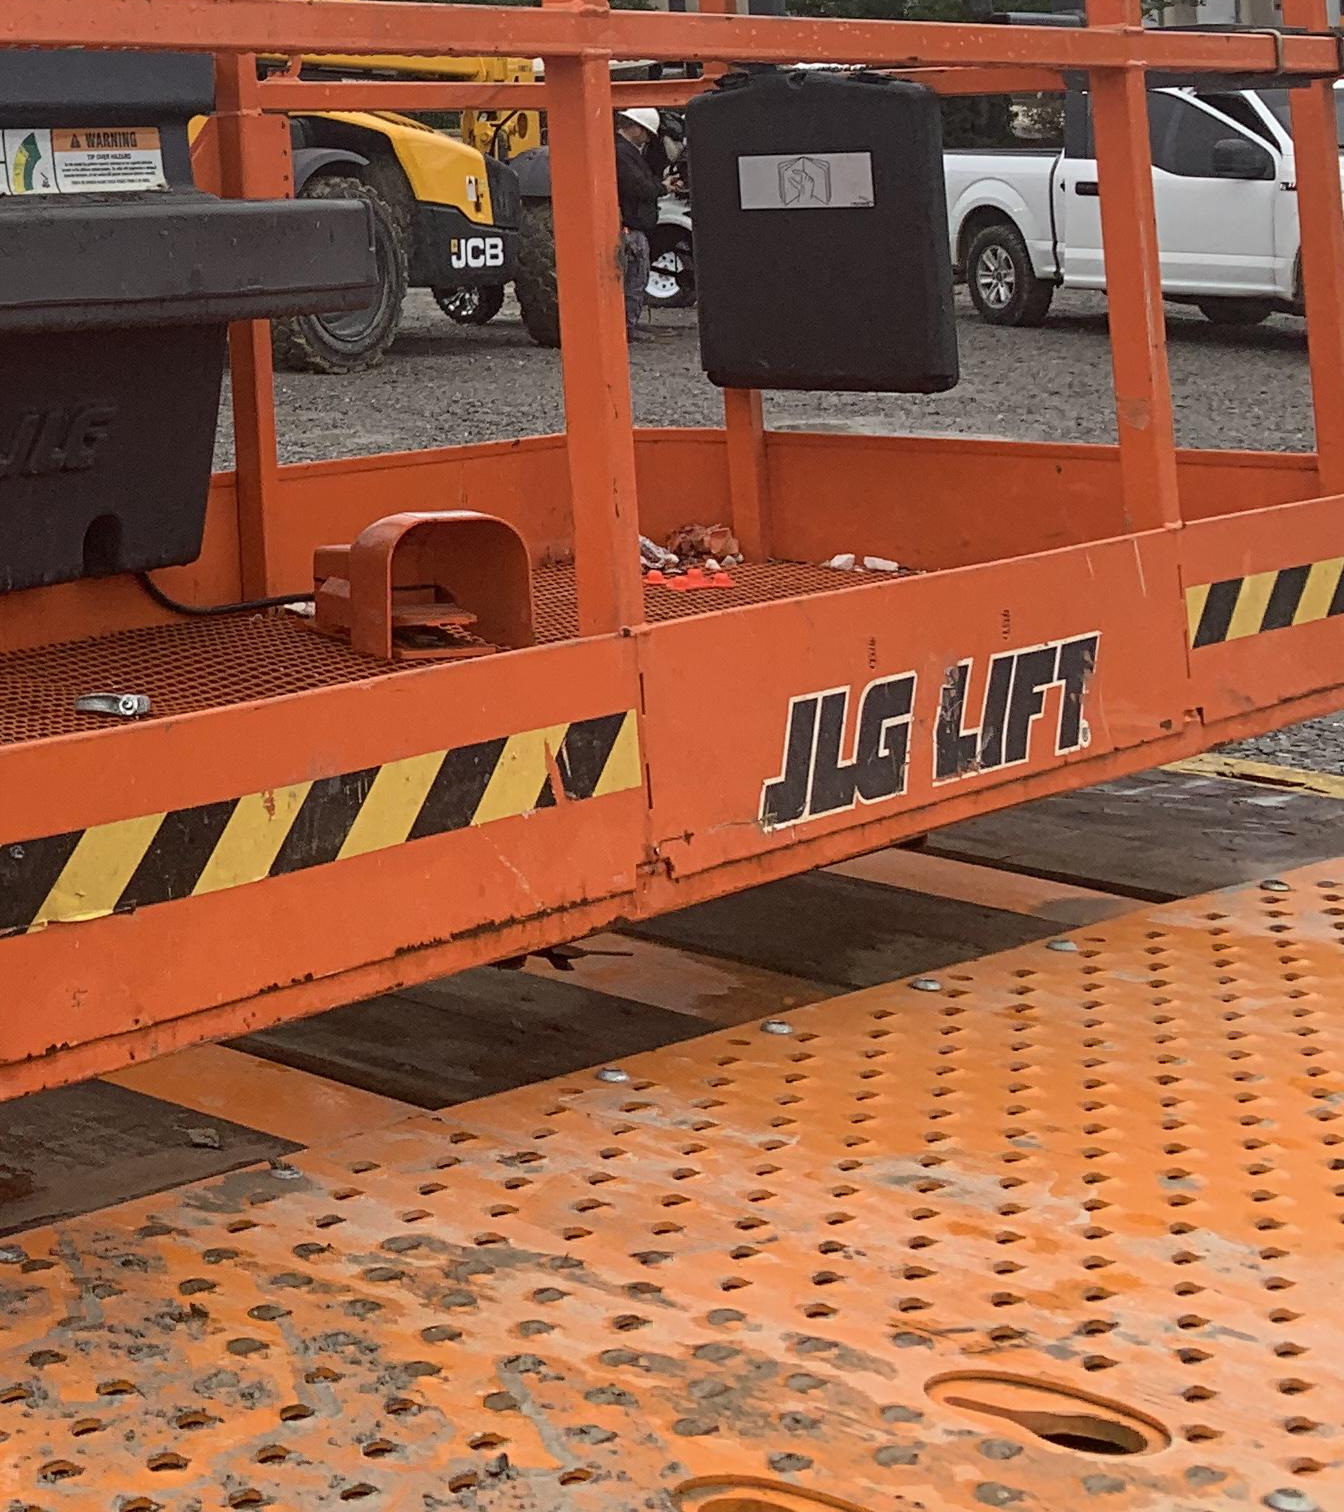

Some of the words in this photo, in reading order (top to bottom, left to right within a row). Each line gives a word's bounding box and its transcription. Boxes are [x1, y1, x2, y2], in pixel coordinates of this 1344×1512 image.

[85, 131, 138, 148] WARNING
[450, 237, 504, 269] JCB
[759, 672, 917, 831] JLG
[932, 631, 1102, 787] LIFT
